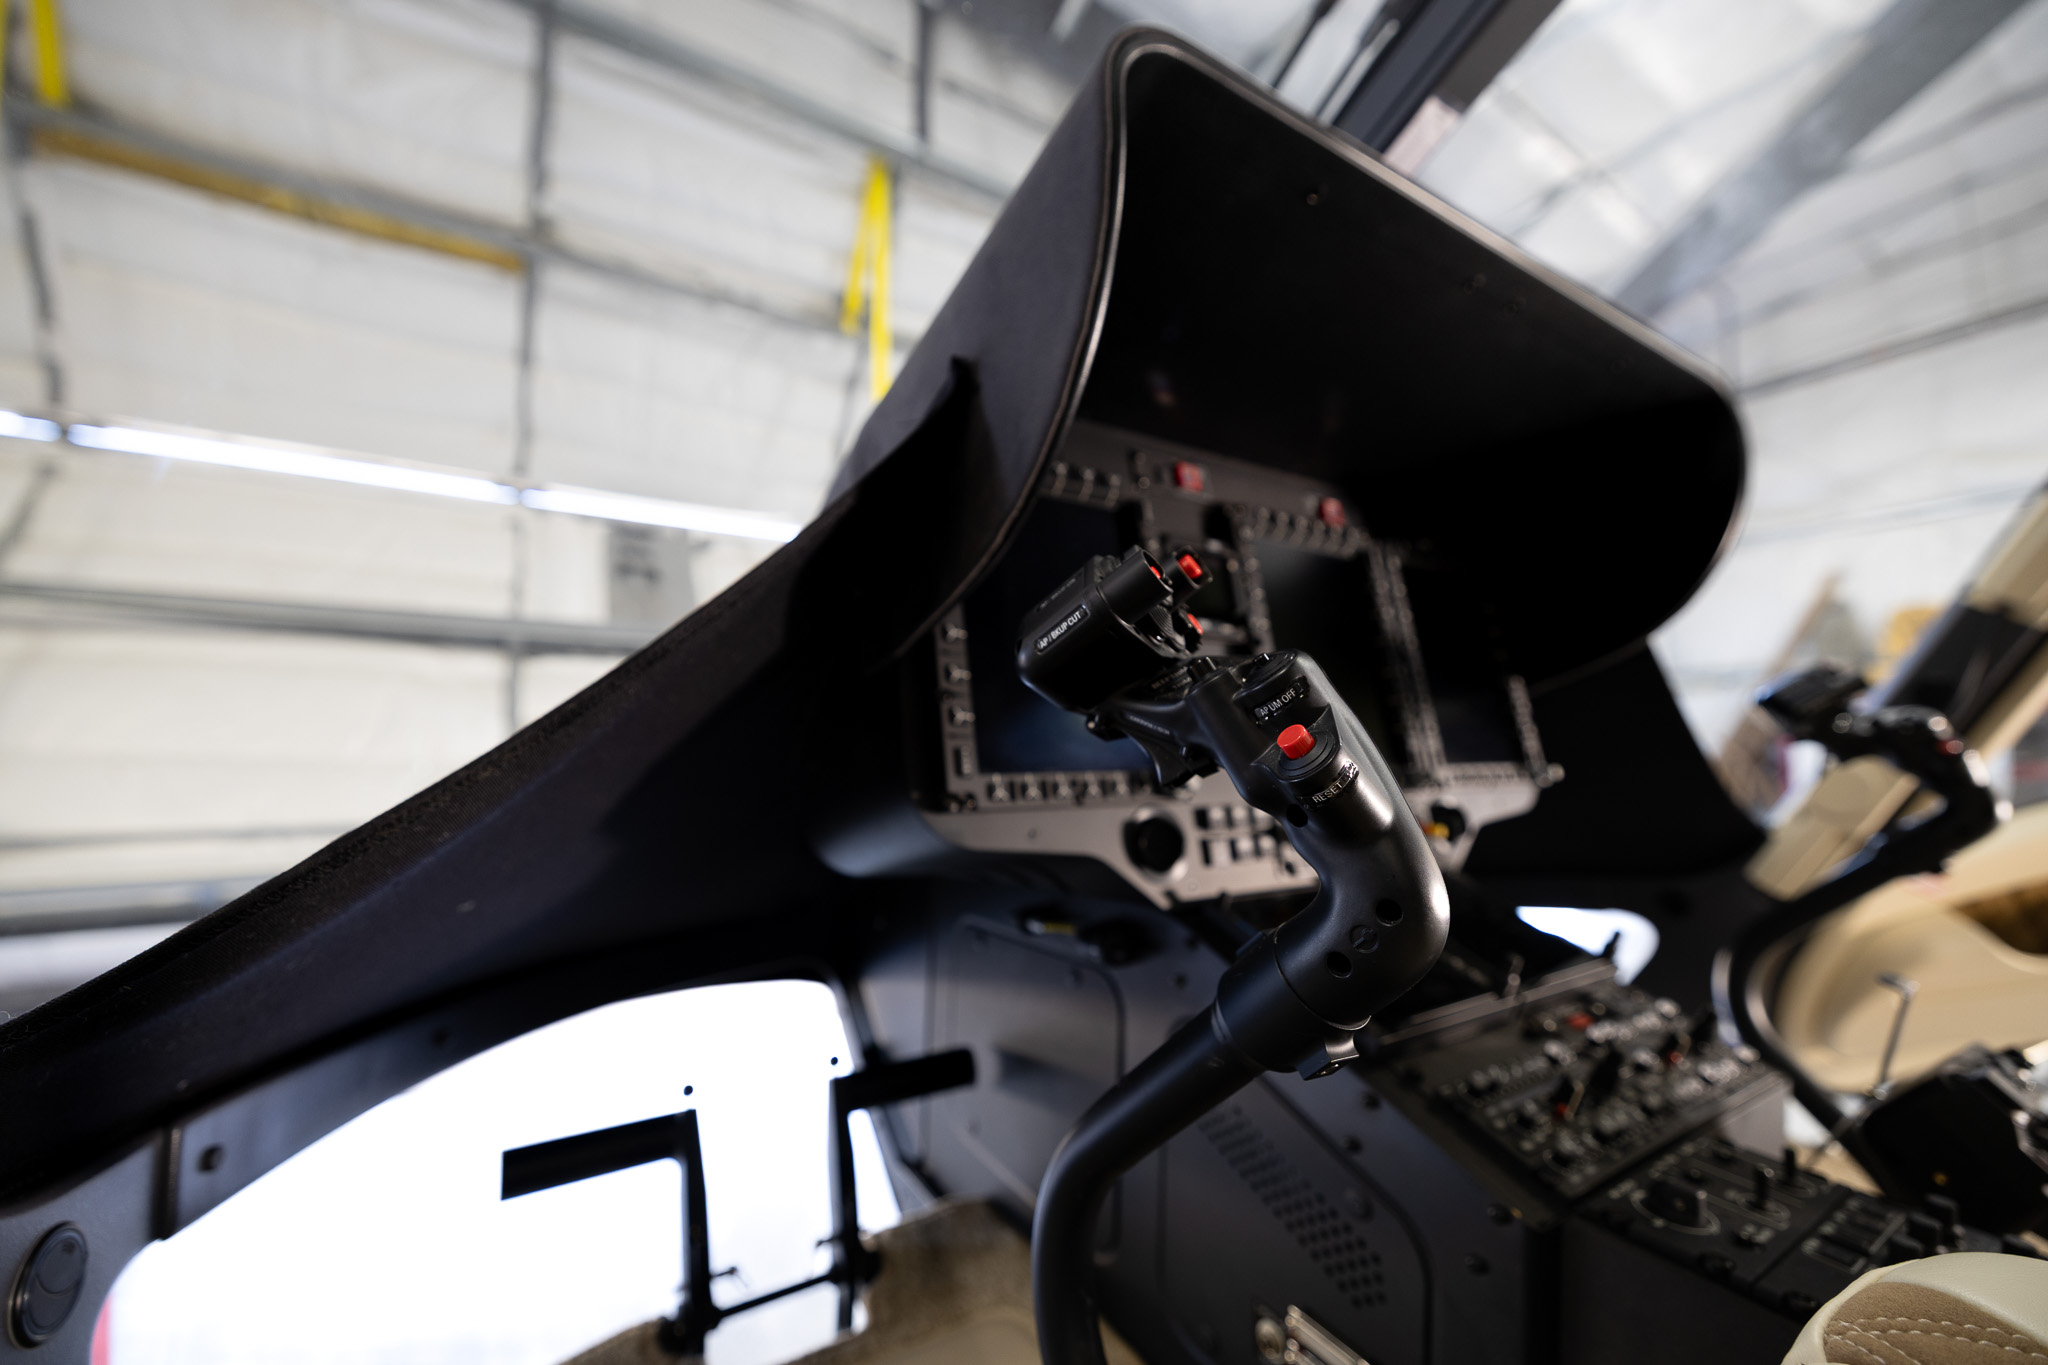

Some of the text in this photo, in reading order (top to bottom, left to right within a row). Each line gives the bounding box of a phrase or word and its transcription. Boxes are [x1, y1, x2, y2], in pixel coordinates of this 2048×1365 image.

[1038, 637, 1048, 649] AP
[1050, 621, 1068, 640] BKUP
[1067, 610, 1081, 626] CUT
[1260, 688, 1296, 716] AP UM OFF
[1311, 780, 1344, 803] RESET
